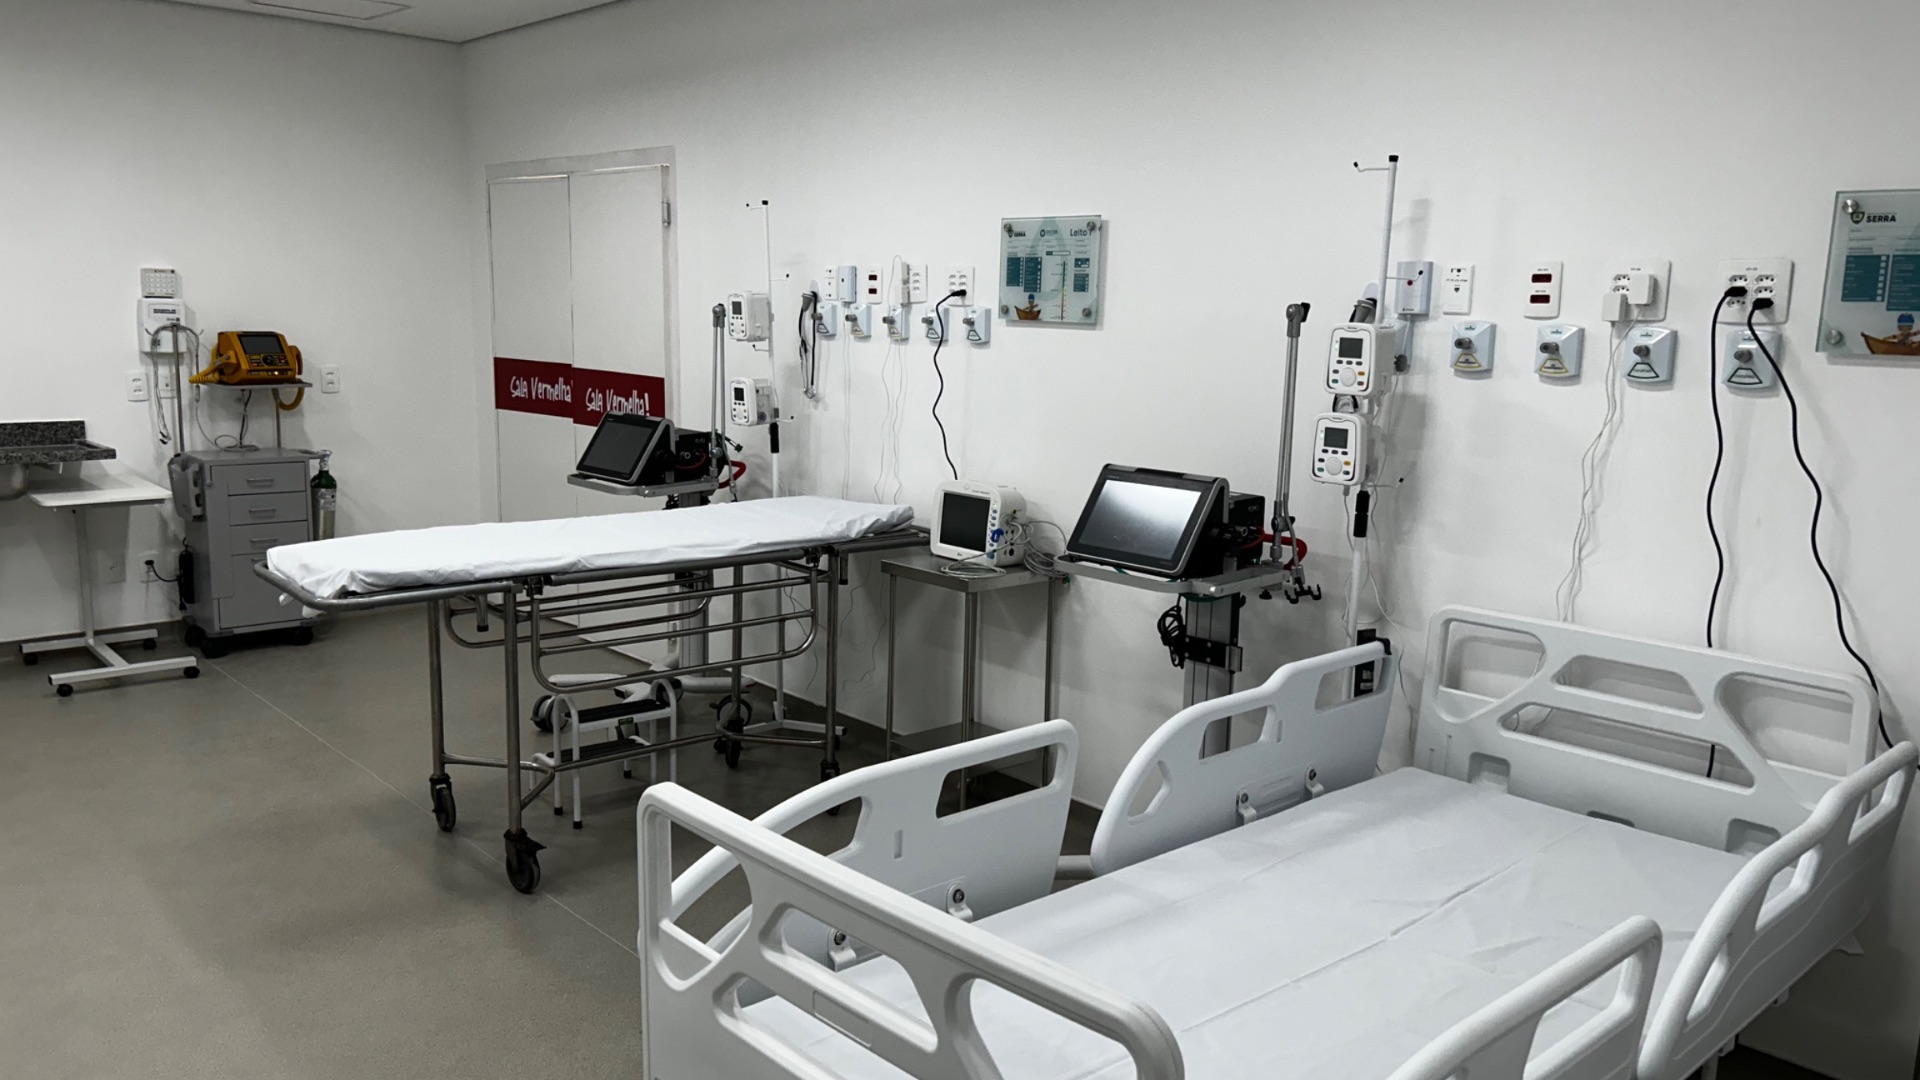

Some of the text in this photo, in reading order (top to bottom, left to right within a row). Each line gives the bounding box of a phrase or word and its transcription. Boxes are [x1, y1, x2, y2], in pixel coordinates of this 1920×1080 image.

[1866, 215, 1896, 223] SERRA
[1070, 228, 1087, 237] Leito
[606, 389, 650, 416] Vermelha!
